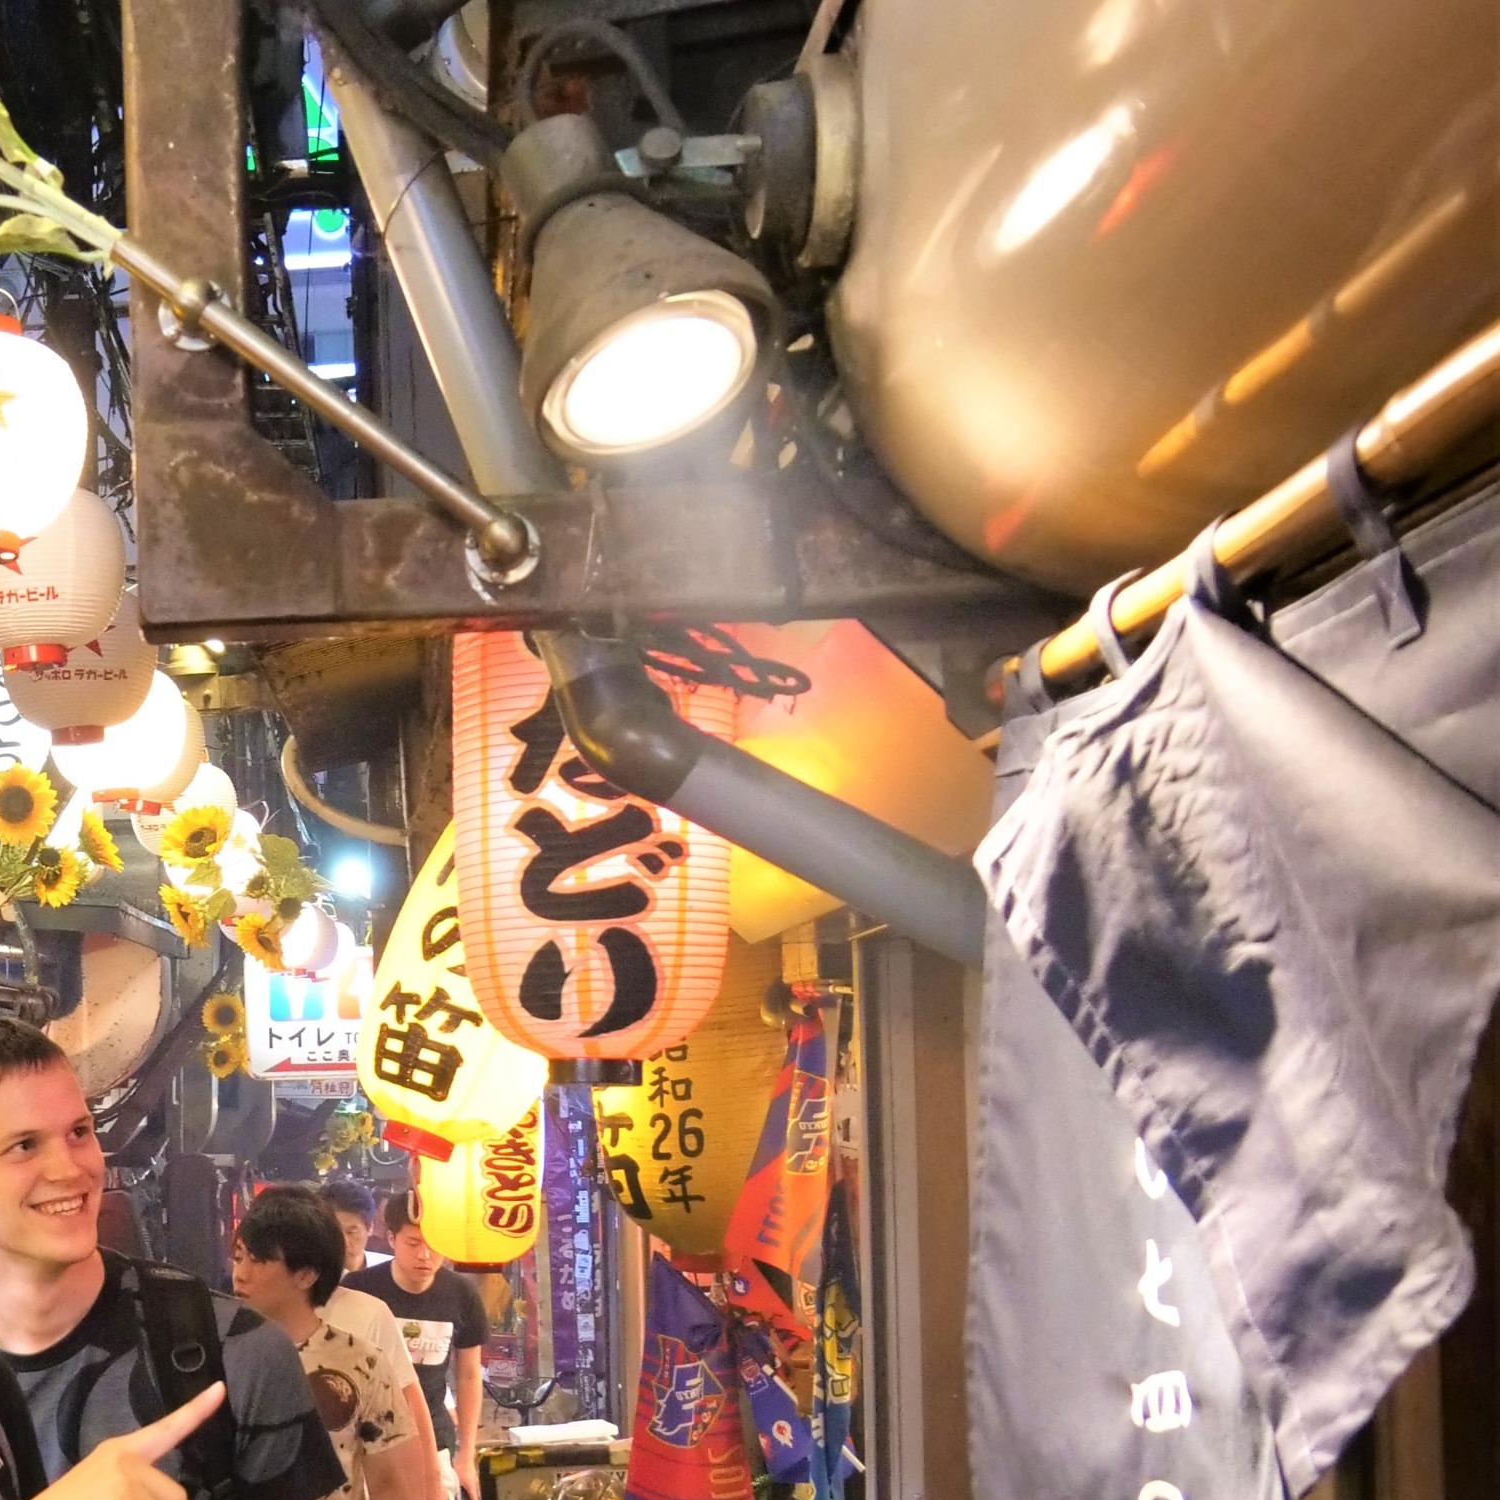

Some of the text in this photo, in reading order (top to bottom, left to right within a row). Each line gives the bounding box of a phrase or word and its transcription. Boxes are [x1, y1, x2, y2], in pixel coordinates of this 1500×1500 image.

[374, 855, 484, 1102] の笛
[268, 1026, 335, 1048] トイレ
[306, 1049, 357, 1062] ここ奥
